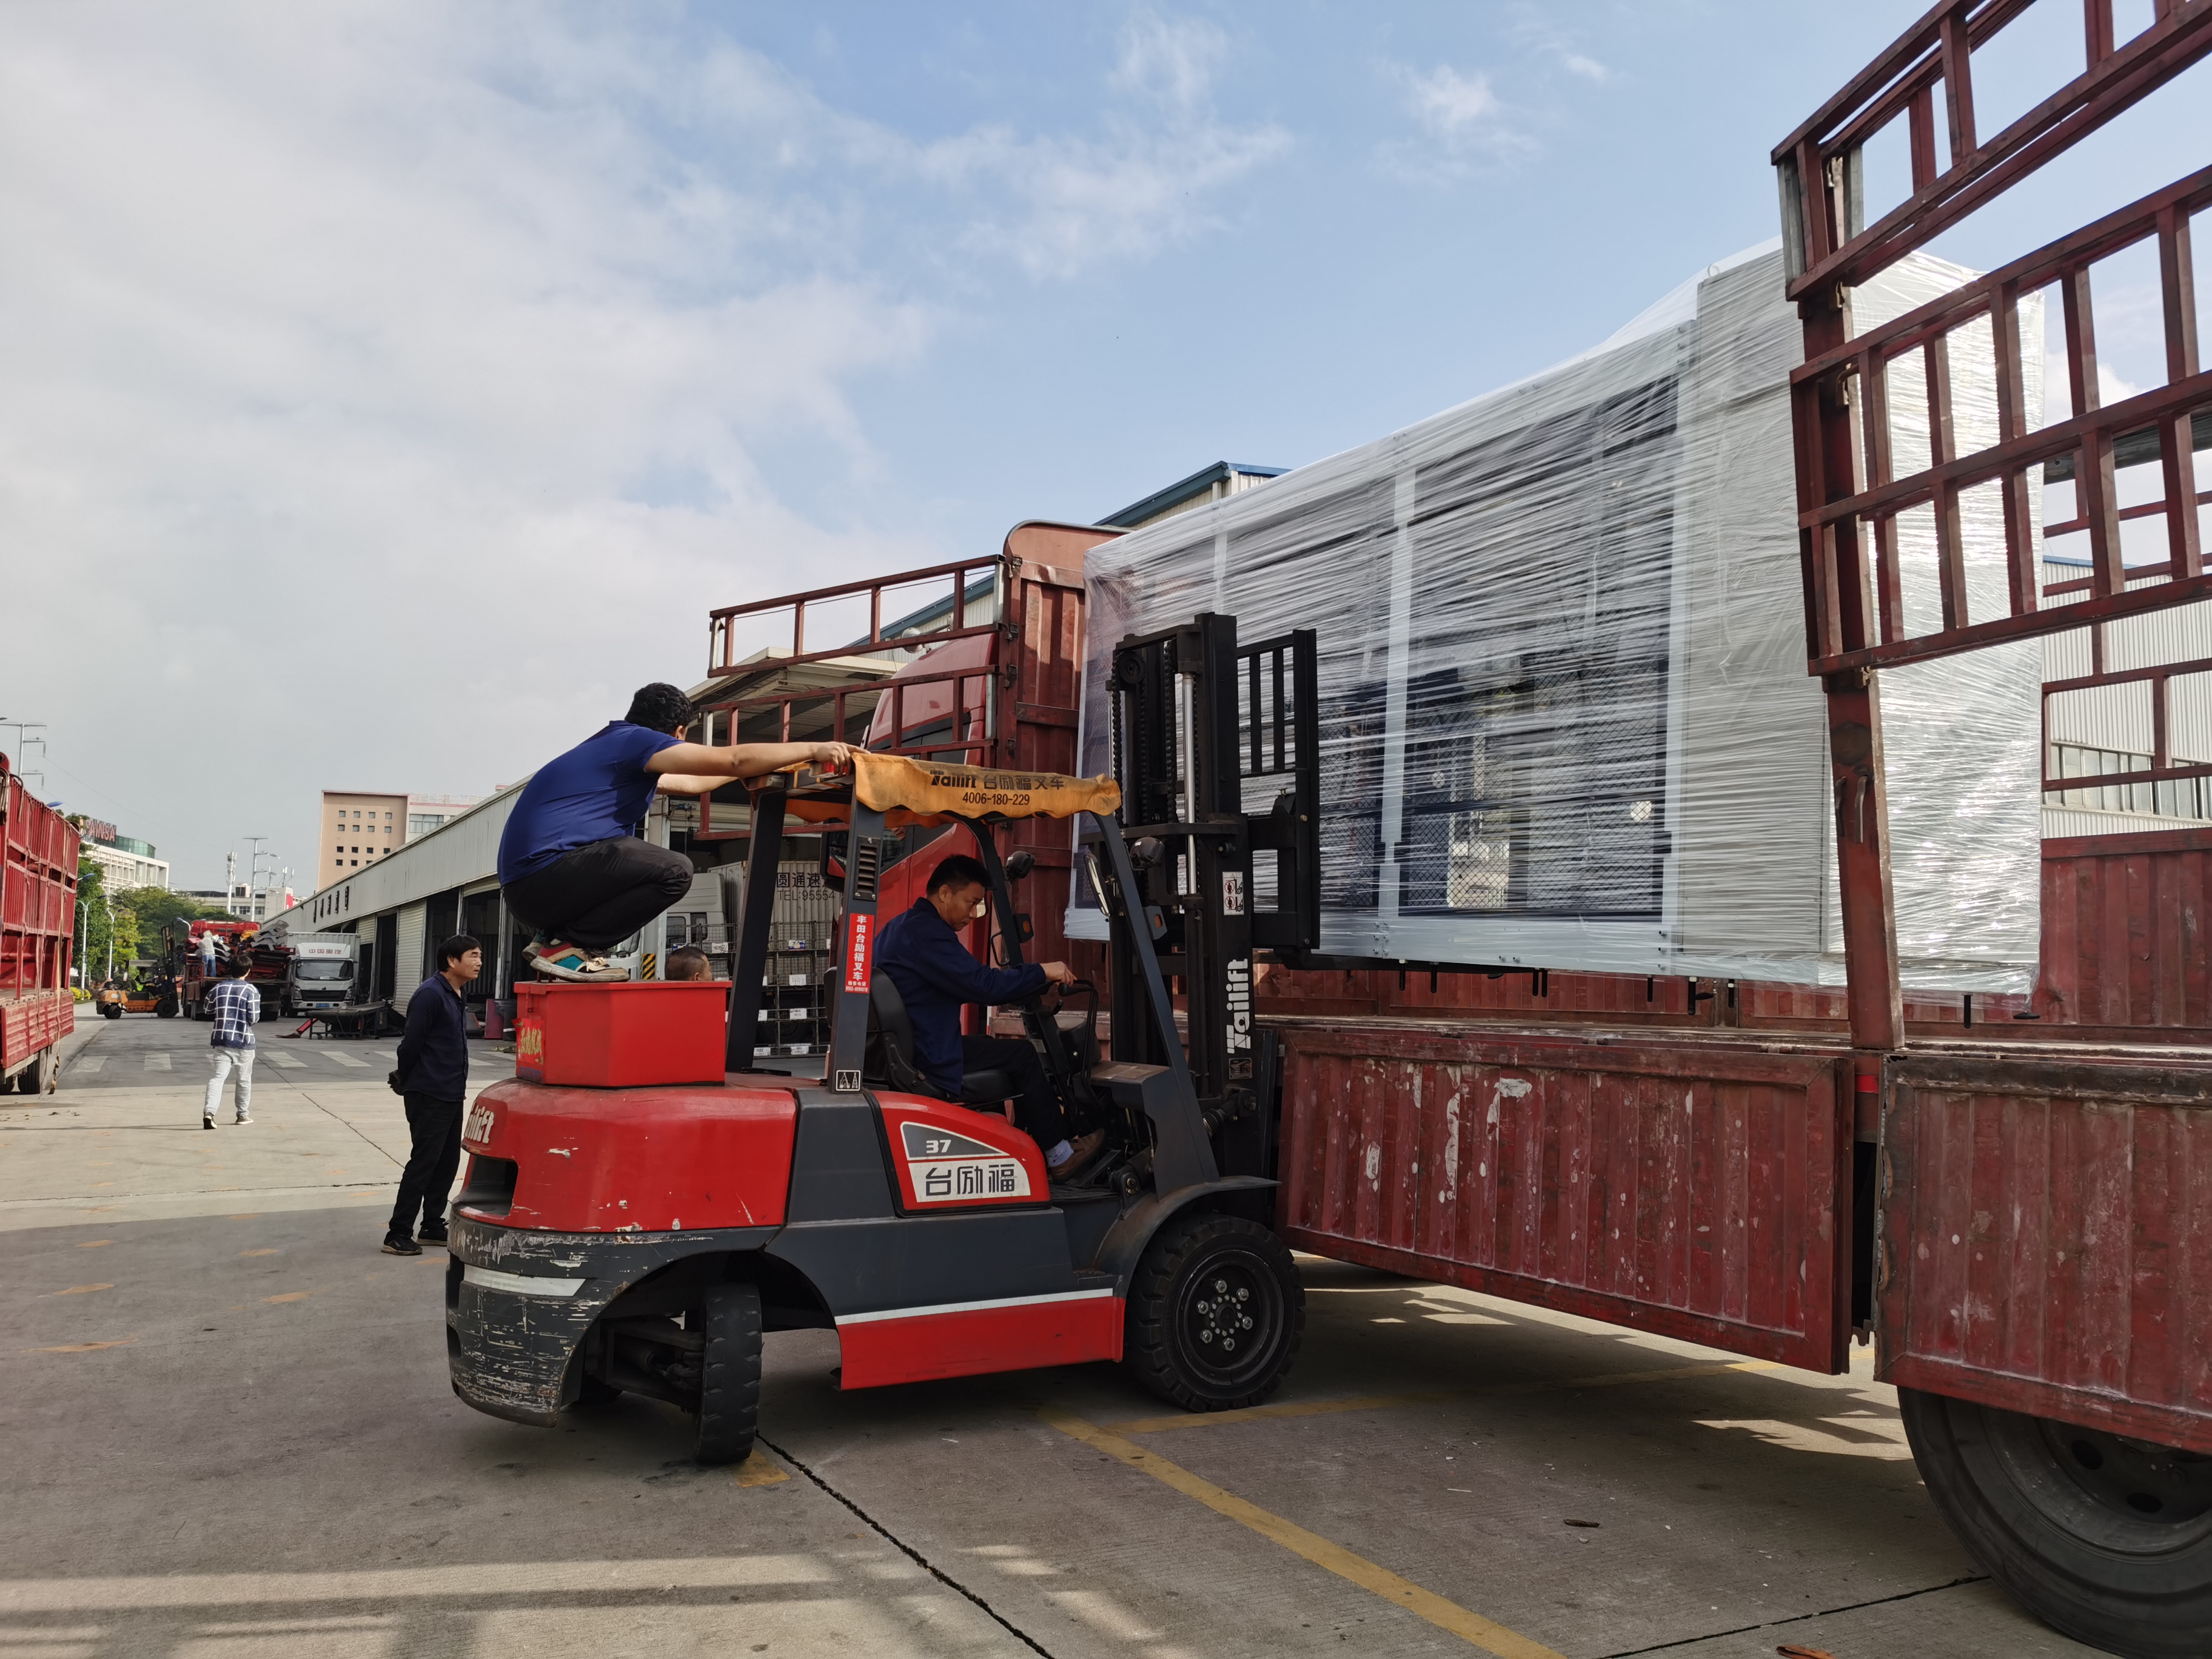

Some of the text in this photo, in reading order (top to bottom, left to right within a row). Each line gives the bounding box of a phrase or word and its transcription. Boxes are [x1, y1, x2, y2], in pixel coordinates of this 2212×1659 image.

[930, 770, 1064, 791] Tailift 台励福叉车
[962, 792, 1030, 806] 4006-180-229
[777, 872, 826, 888] 圆通速
[777, 890, 836, 901] TEL:95554
[853, 915, 866, 981] 丰田台励福叉车
[1226, 958, 1251, 1054] Tailift
[926, 1139, 951, 1153] 37
[925, 1164, 1015, 1196] 台励福
